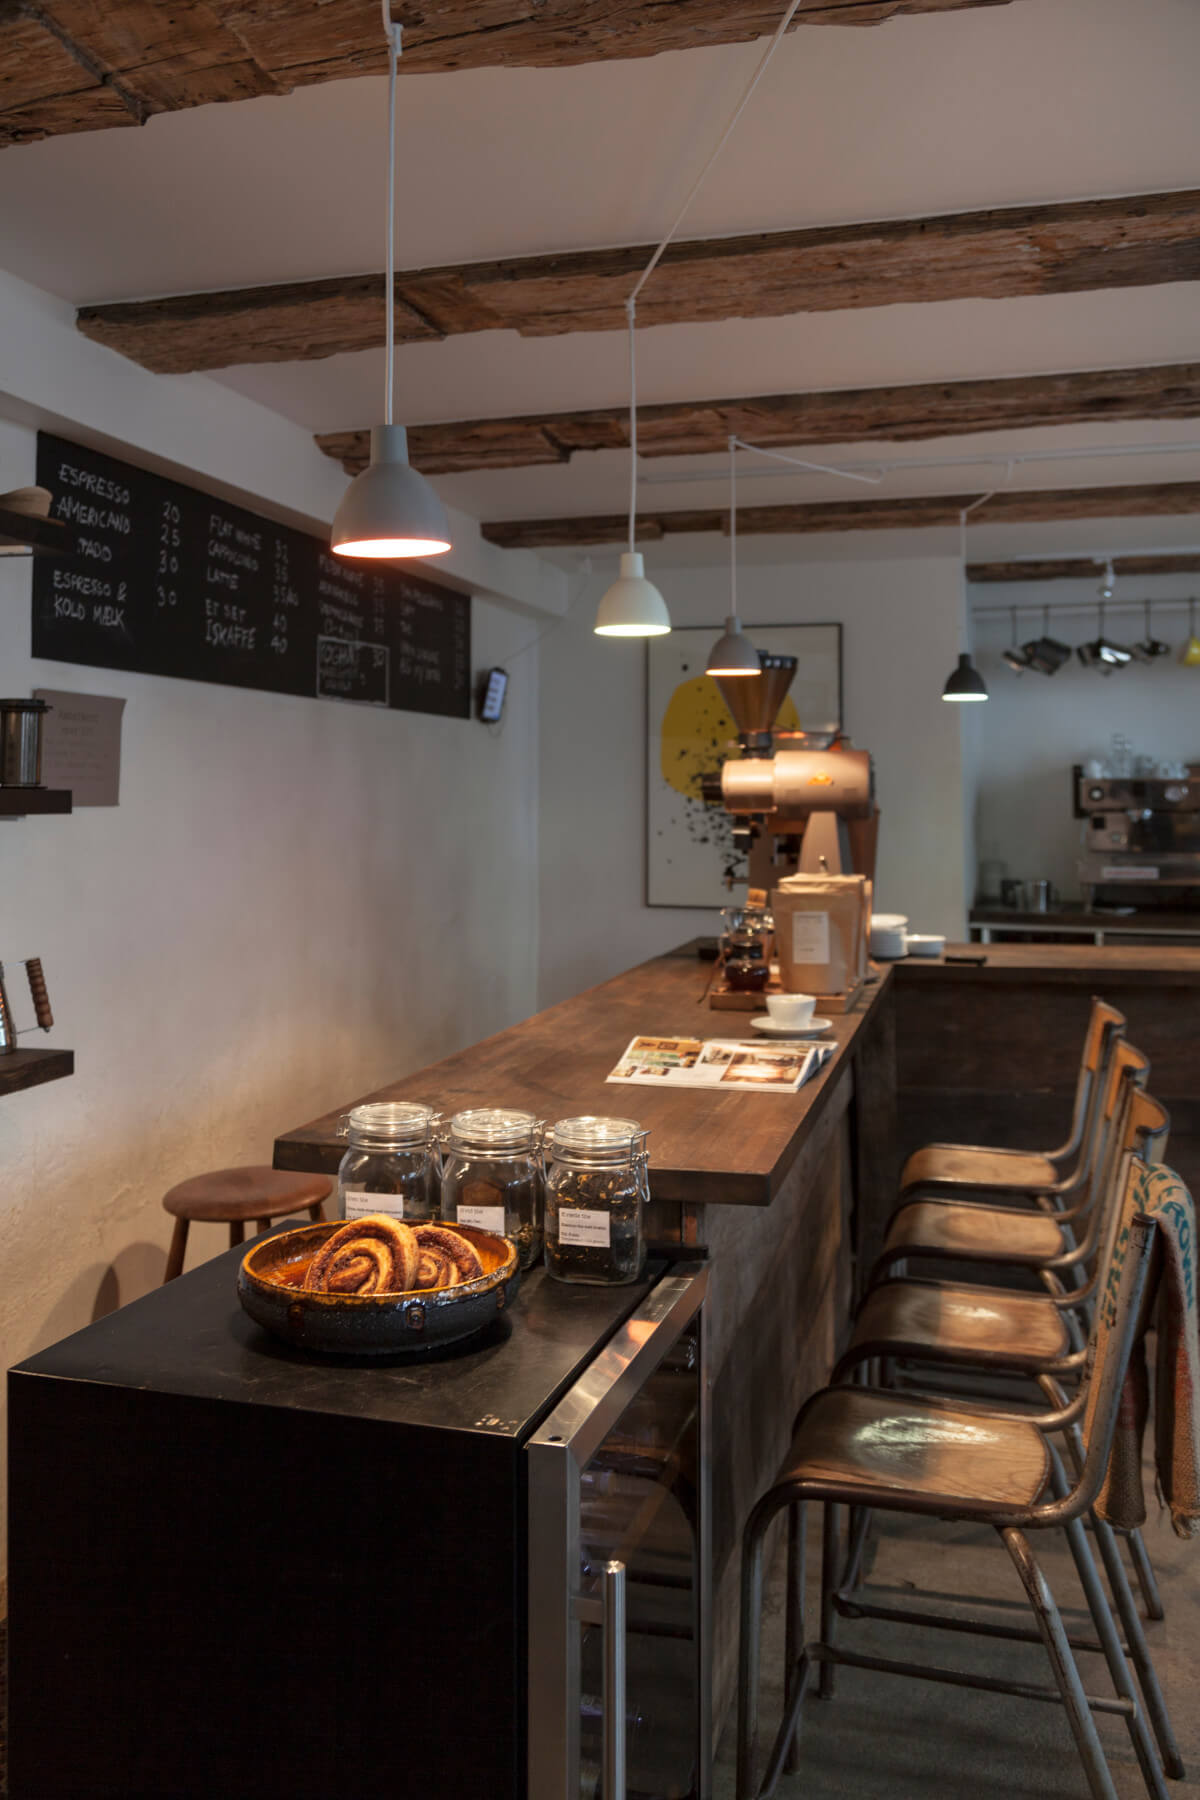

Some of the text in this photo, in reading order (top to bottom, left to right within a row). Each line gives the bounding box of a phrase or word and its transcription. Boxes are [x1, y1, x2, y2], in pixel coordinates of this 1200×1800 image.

[58, 463, 180, 523] ESPRESSO 20
[56, 496, 180, 547] AMERICANO 25
[77, 537, 178, 573] TADO 30
[53, 570, 111, 596] ESPRESSO
[157, 585, 177, 607] 30
[206, 565, 239, 590] LATTE
[54, 594, 85, 620] KOLD
[205, 598, 220, 616] ET
[205, 618, 288, 654] ISKAFFE 40
